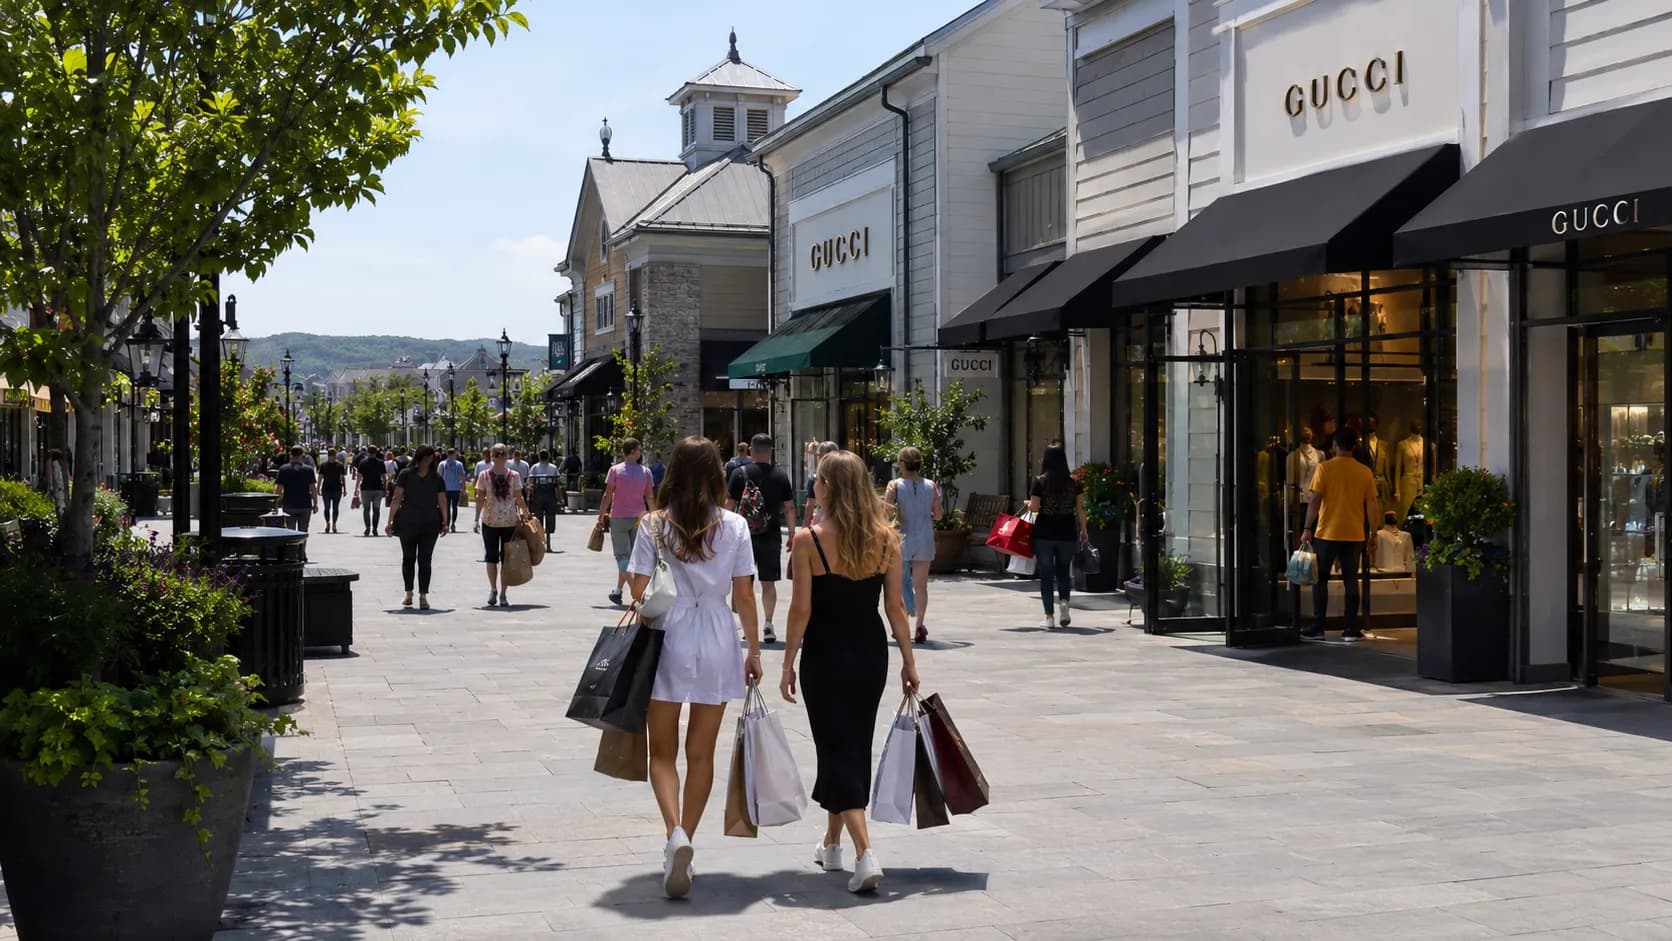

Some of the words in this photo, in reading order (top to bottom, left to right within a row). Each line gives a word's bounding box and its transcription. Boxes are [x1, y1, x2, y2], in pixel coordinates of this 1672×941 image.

[1285, 50, 1404, 117] GUCCI
[1551, 198, 1639, 235] GUCCI
[810, 226, 869, 272] GUCCI
[951, 358, 992, 371] GUCCI
